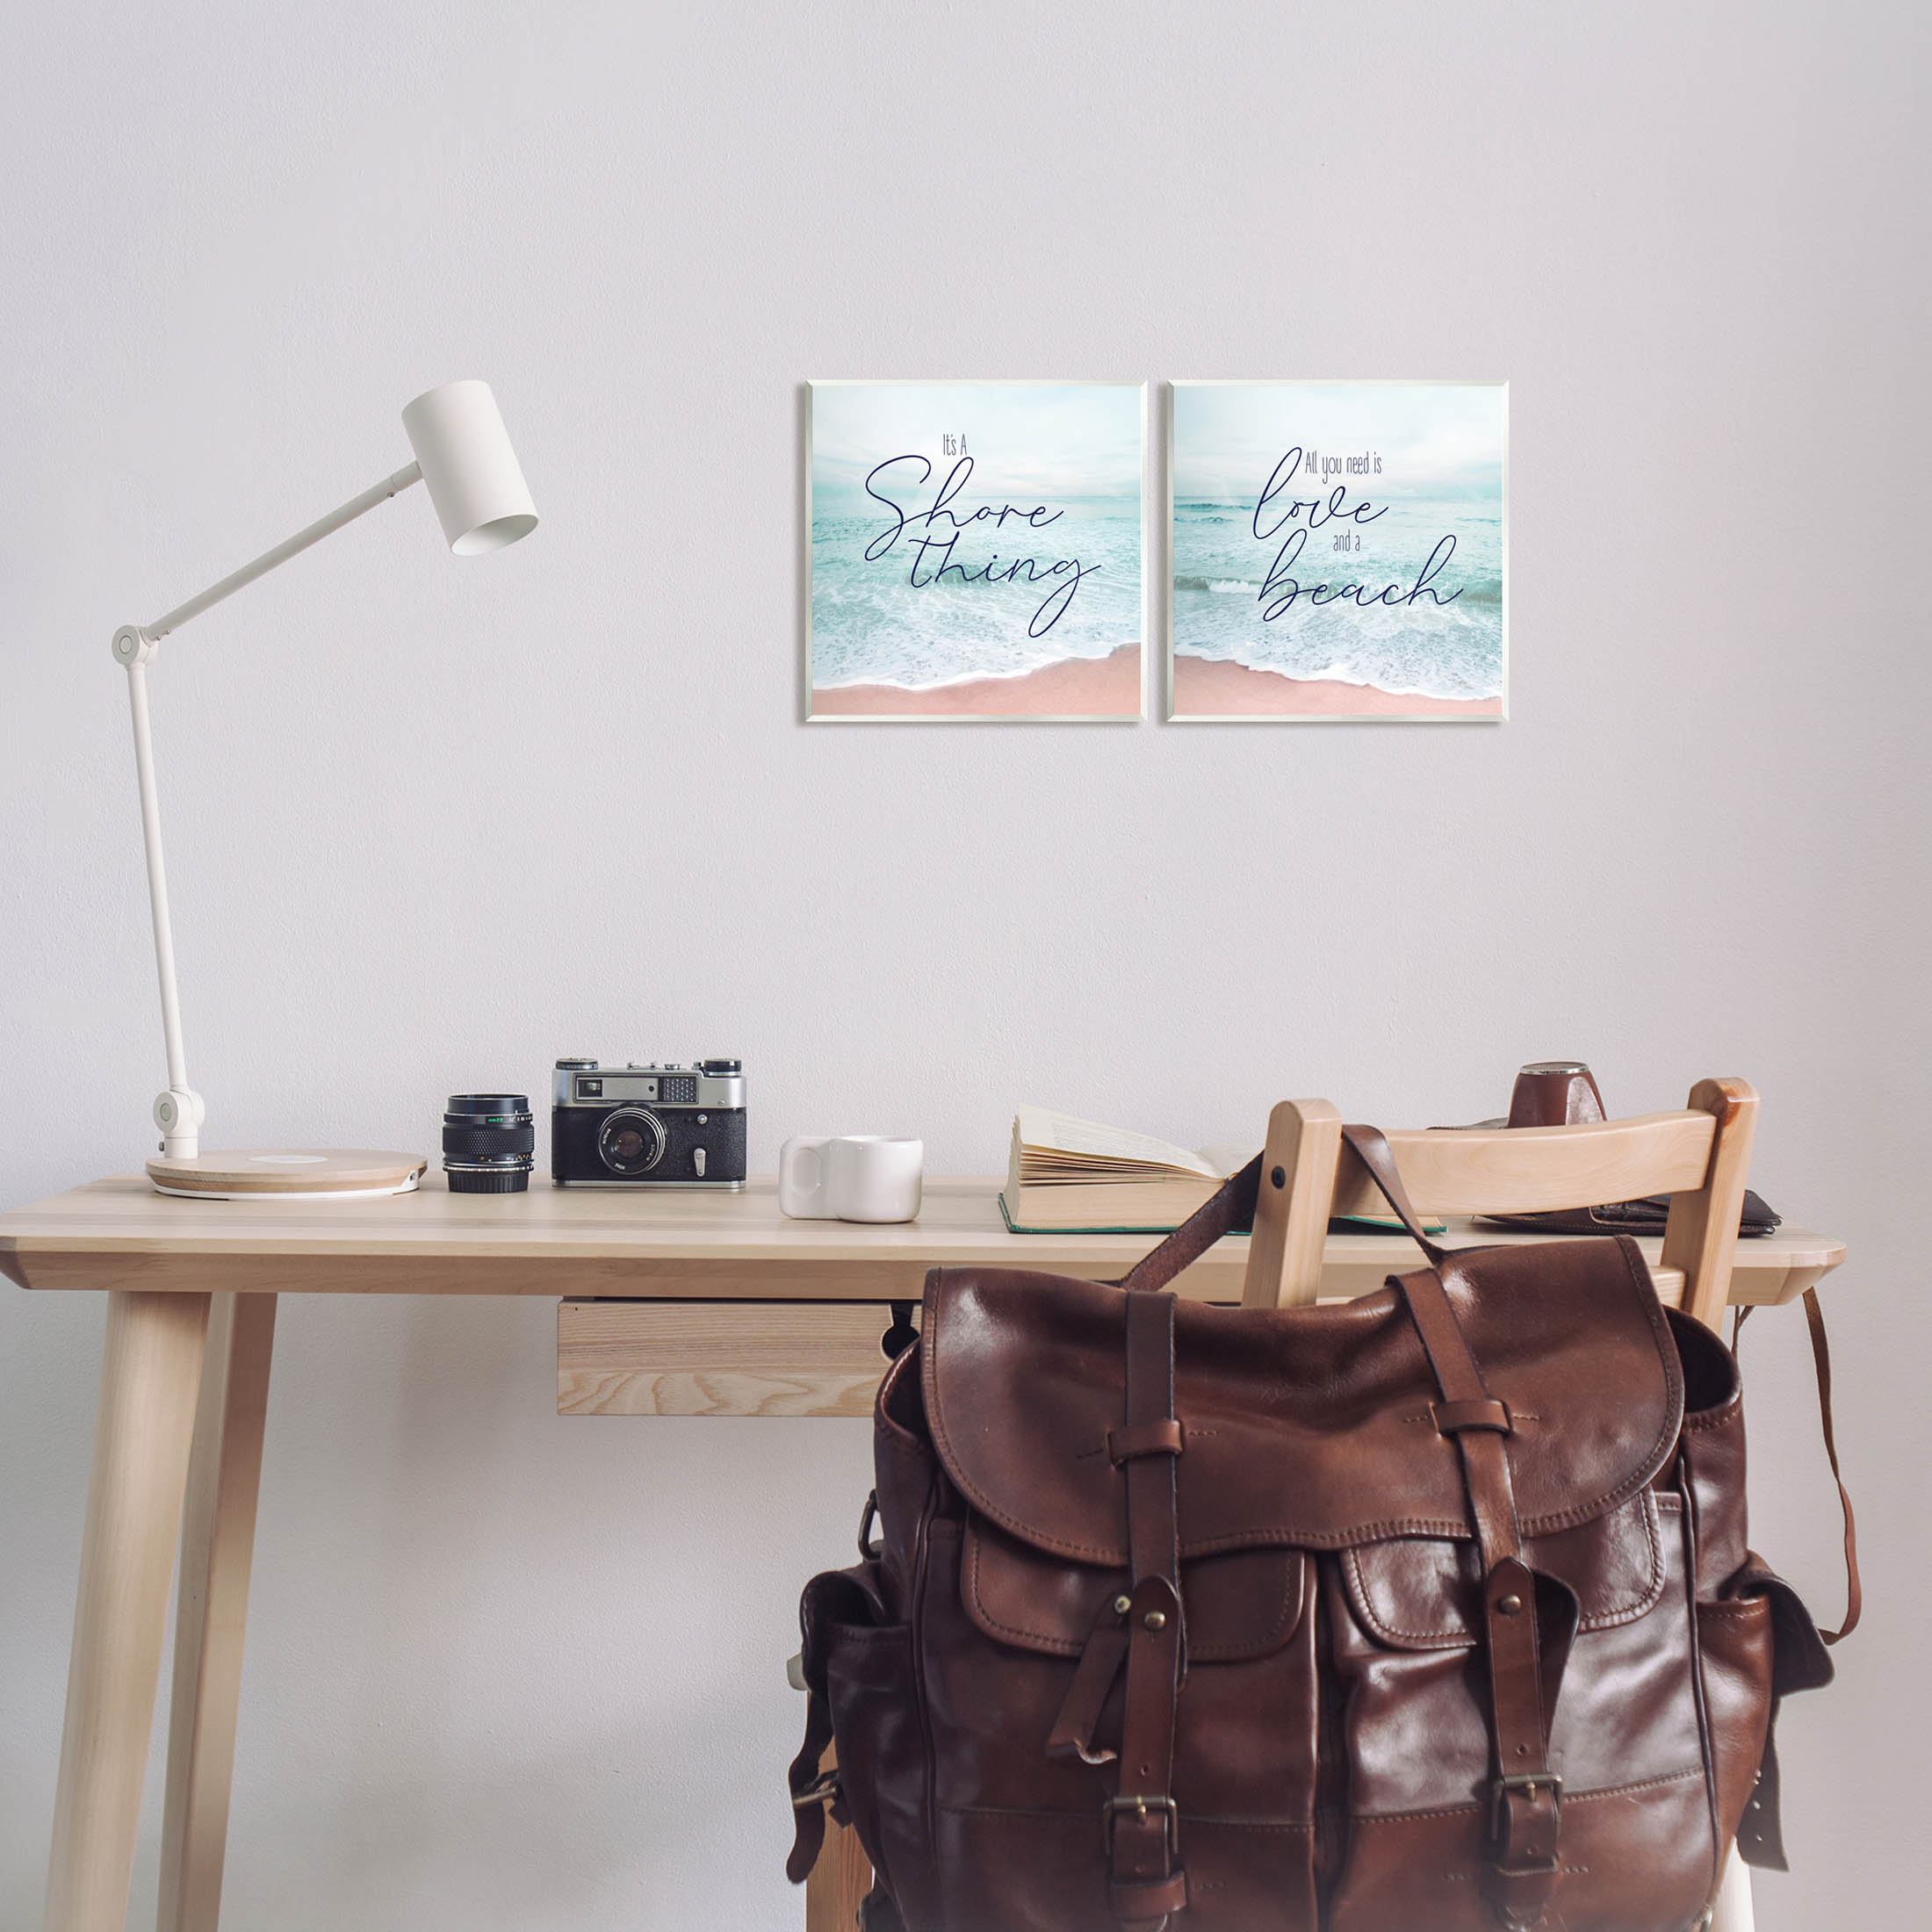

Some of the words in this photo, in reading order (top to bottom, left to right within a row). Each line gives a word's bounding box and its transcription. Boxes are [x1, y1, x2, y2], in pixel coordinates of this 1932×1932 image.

[942, 434, 956, 456] It's
[960, 434, 967, 456] A
[1305, 451, 1317, 474] All
[1323, 456, 1342, 485] you
[1346, 451, 1369, 474] need
[1373, 452, 1382, 474] is
[864, 455, 1064, 561] Shore
[1252, 446, 1389, 539] love
[908, 530, 1102, 638] thing
[1258, 529, 1464, 622] beach
[1333, 530, 1351, 551] and
[1354, 535, 1360, 551] a
